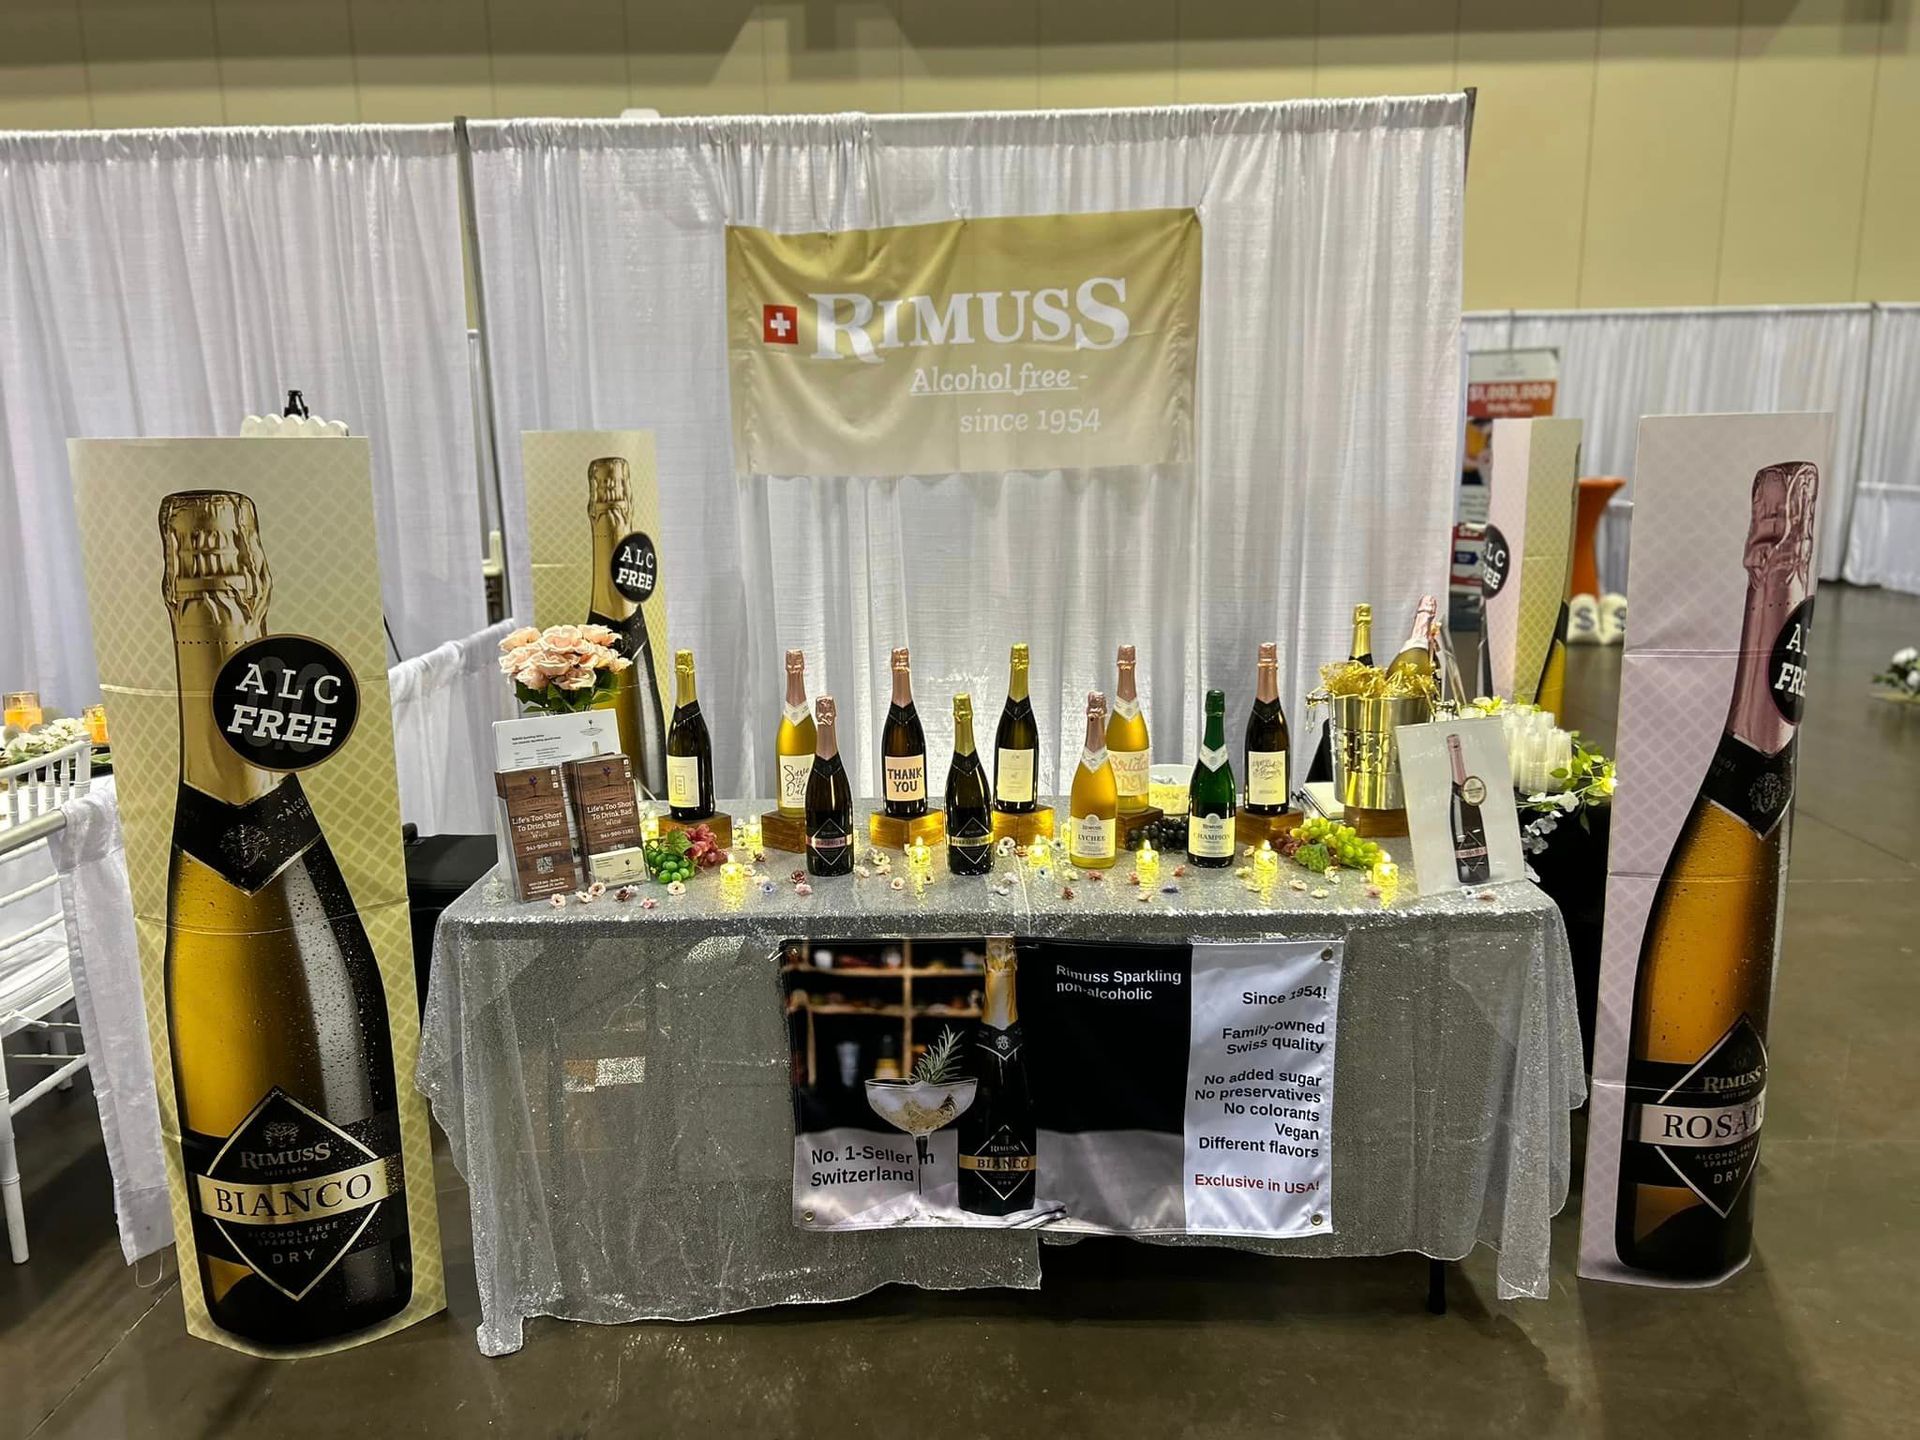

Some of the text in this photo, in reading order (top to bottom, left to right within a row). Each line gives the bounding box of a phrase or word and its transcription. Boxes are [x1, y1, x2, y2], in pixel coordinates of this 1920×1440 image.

[808, 277, 1130, 363] RIMUSS
[910, 363, 1012, 393] Alcohol
[1013, 362, 1071, 395] free
[960, 408, 1101, 434] since 1954
[620, 546, 654, 568] ALC
[616, 568, 653, 590] FREE
[235, 663, 342, 704] ALC
[227, 704, 337, 746] FREE
[887, 767, 922, 780] THANK
[893, 780, 918, 792] YOU
[512, 816, 530, 825] Life's
[601, 811, 620, 819] Drink
[527, 822, 546, 831] Drink
[547, 819, 560, 828] Bad
[1056, 964, 1181, 985] Rimuss Sparkling
[1056, 982, 1152, 1000] non-alcoholic
[1242, 986, 1327, 1004] Since 1954!
[1222, 1020, 1325, 1039] Family-owned
[1226, 1037, 1324, 1054] Swiss quality
[1204, 1069, 1322, 1087] No added sugar
[1195, 1087, 1321, 1103] No preservatives
[1224, 1102, 1320, 1122] No colorants
[1275, 1122, 1319, 1141] Vegan
[240, 1142, 331, 1169] RIMUSS
[811, 1148, 839, 1165] No.
[845, 1145, 913, 1164] 1-Seller
[1199, 1137, 1319, 1158] Different flavors
[977, 1159, 1029, 1168] BIANCO
[811, 1166, 914, 1187] Switzerland
[1195, 1173, 1319, 1194] Exclusive in USA!
[1713, 1167, 1740, 1184] DRY
[214, 1173, 371, 1217] BIANCO
[309, 1221, 338, 1233] FREE
[272, 1248, 315, 1264] DRY
